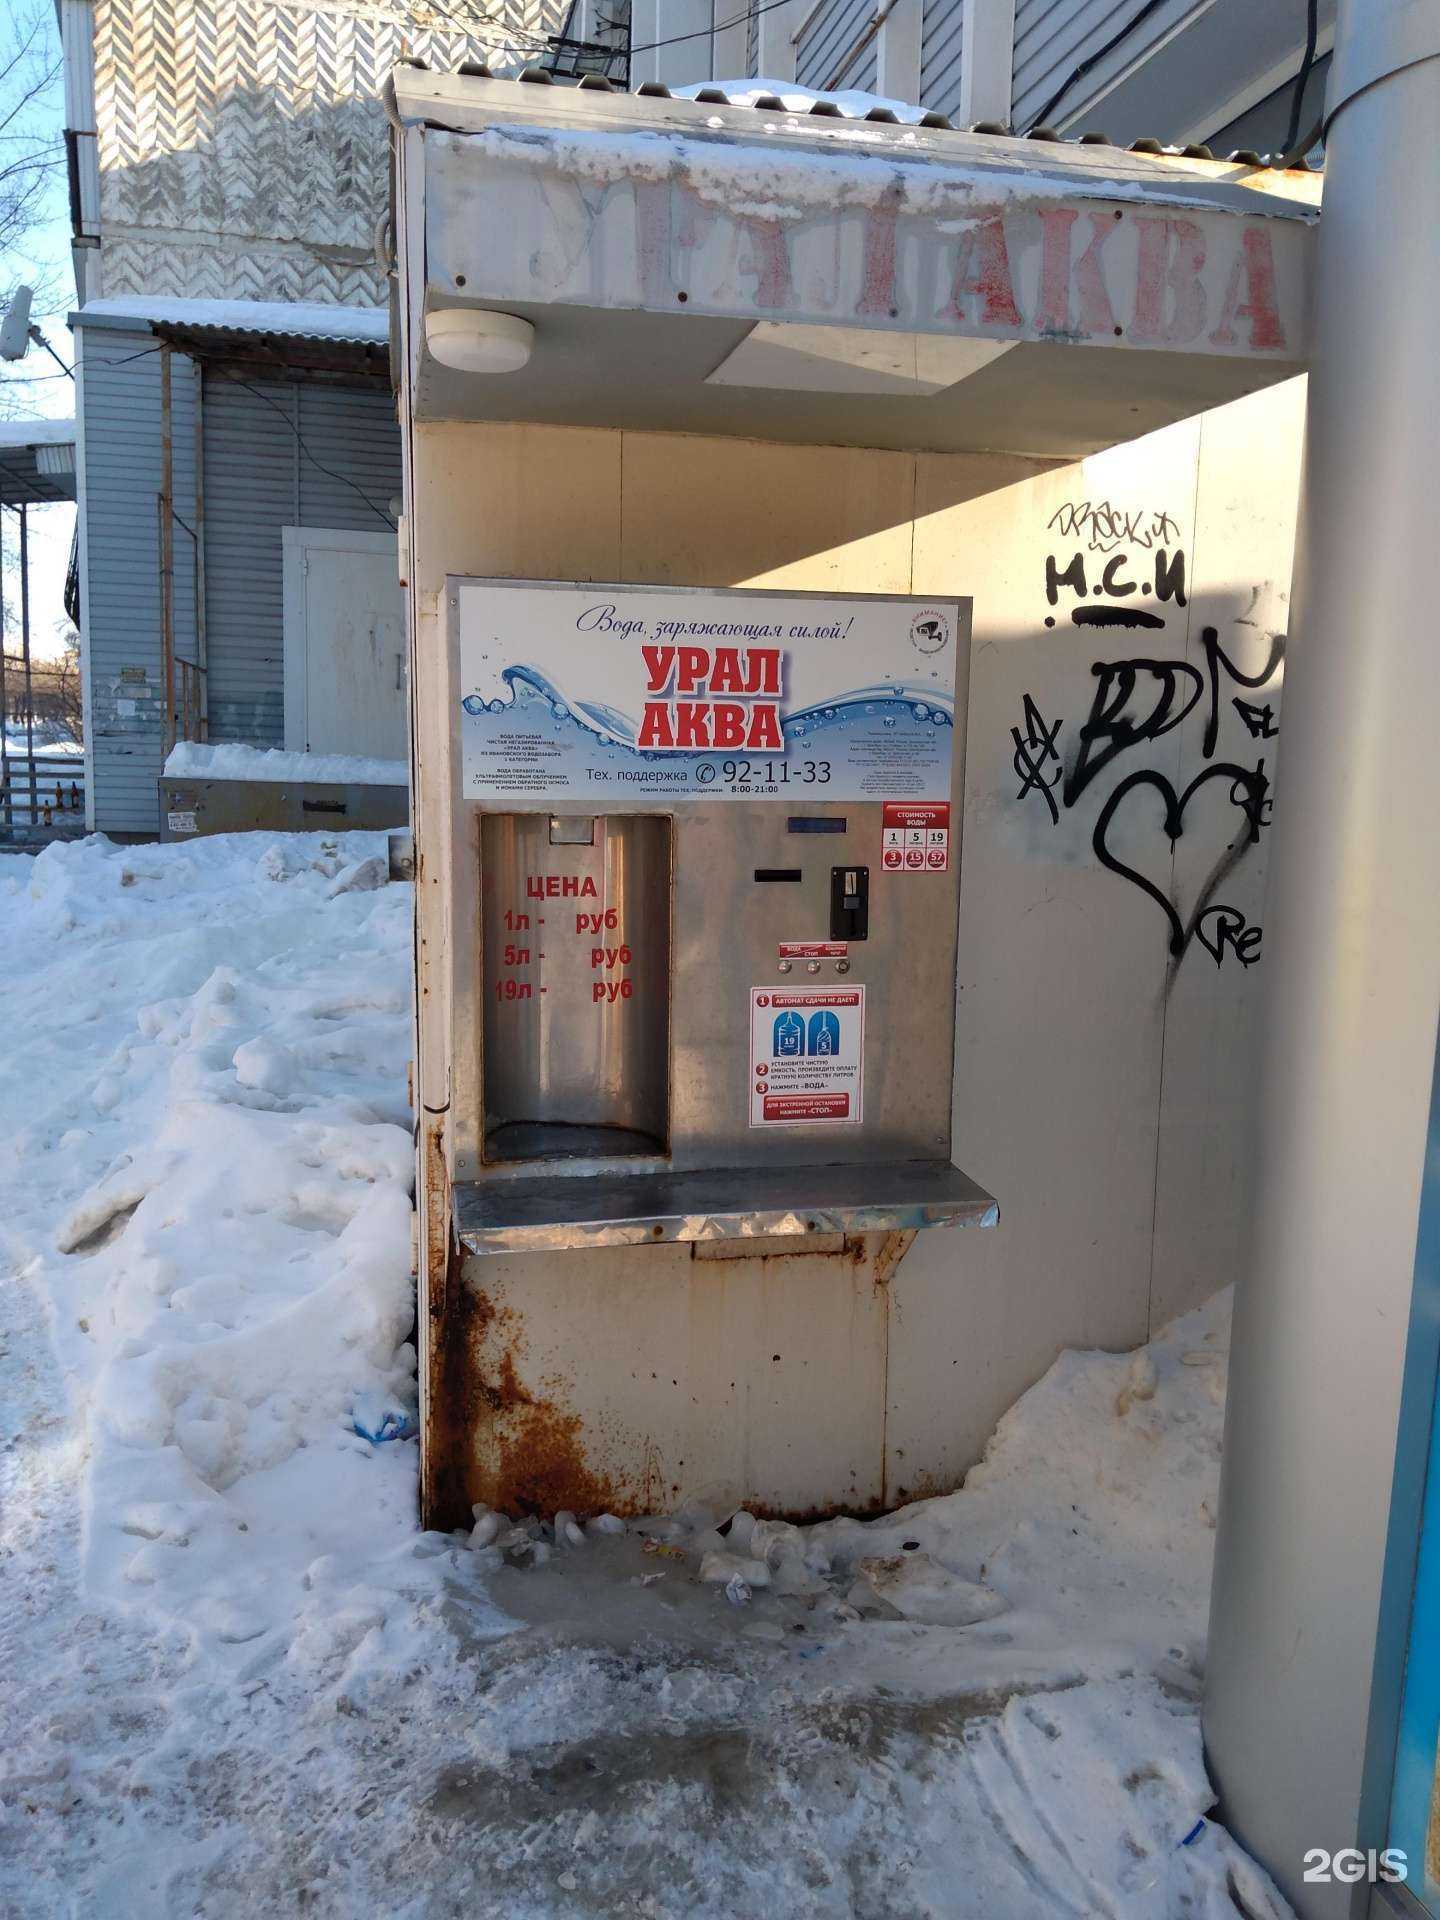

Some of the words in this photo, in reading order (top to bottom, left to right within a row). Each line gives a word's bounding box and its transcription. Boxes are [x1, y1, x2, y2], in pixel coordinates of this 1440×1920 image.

[933, 206, 1286, 351] АКВА
[576, 604, 647, 640] Вода,
[650, 618, 783, 641] заряжающая
[788, 616, 855, 639] силой!
[641, 645, 782, 694] УРАЛ
[637, 702, 783, 749] АКВА
[585, 768, 613, 780] Тех.
[617, 771, 688, 784] поддержка
[722, 760, 832, 784] 92-11-33
[731, 786, 779, 794] 8:00-21:00
[890, 832, 897, 842] 1
[912, 832, 920, 842] 5
[930, 832, 944, 842] 19
[890, 852, 896, 861] 3
[910, 852, 921, 861] 15
[930, 853, 942, 861] 57
[527, 876, 598, 901] ЦЕНА
[504, 909, 530, 931] 1л
[576, 908, 618, 934] руб
[504, 944, 530, 966] 5л
[592, 944, 632, 969] руб
[495, 979, 532, 1002] 19л
[592, 978, 633, 1002] руб
[784, 1037, 795, 1045] 19
[821, 1042, 827, 1050] 5
[759, 1066, 766, 1074] 2
